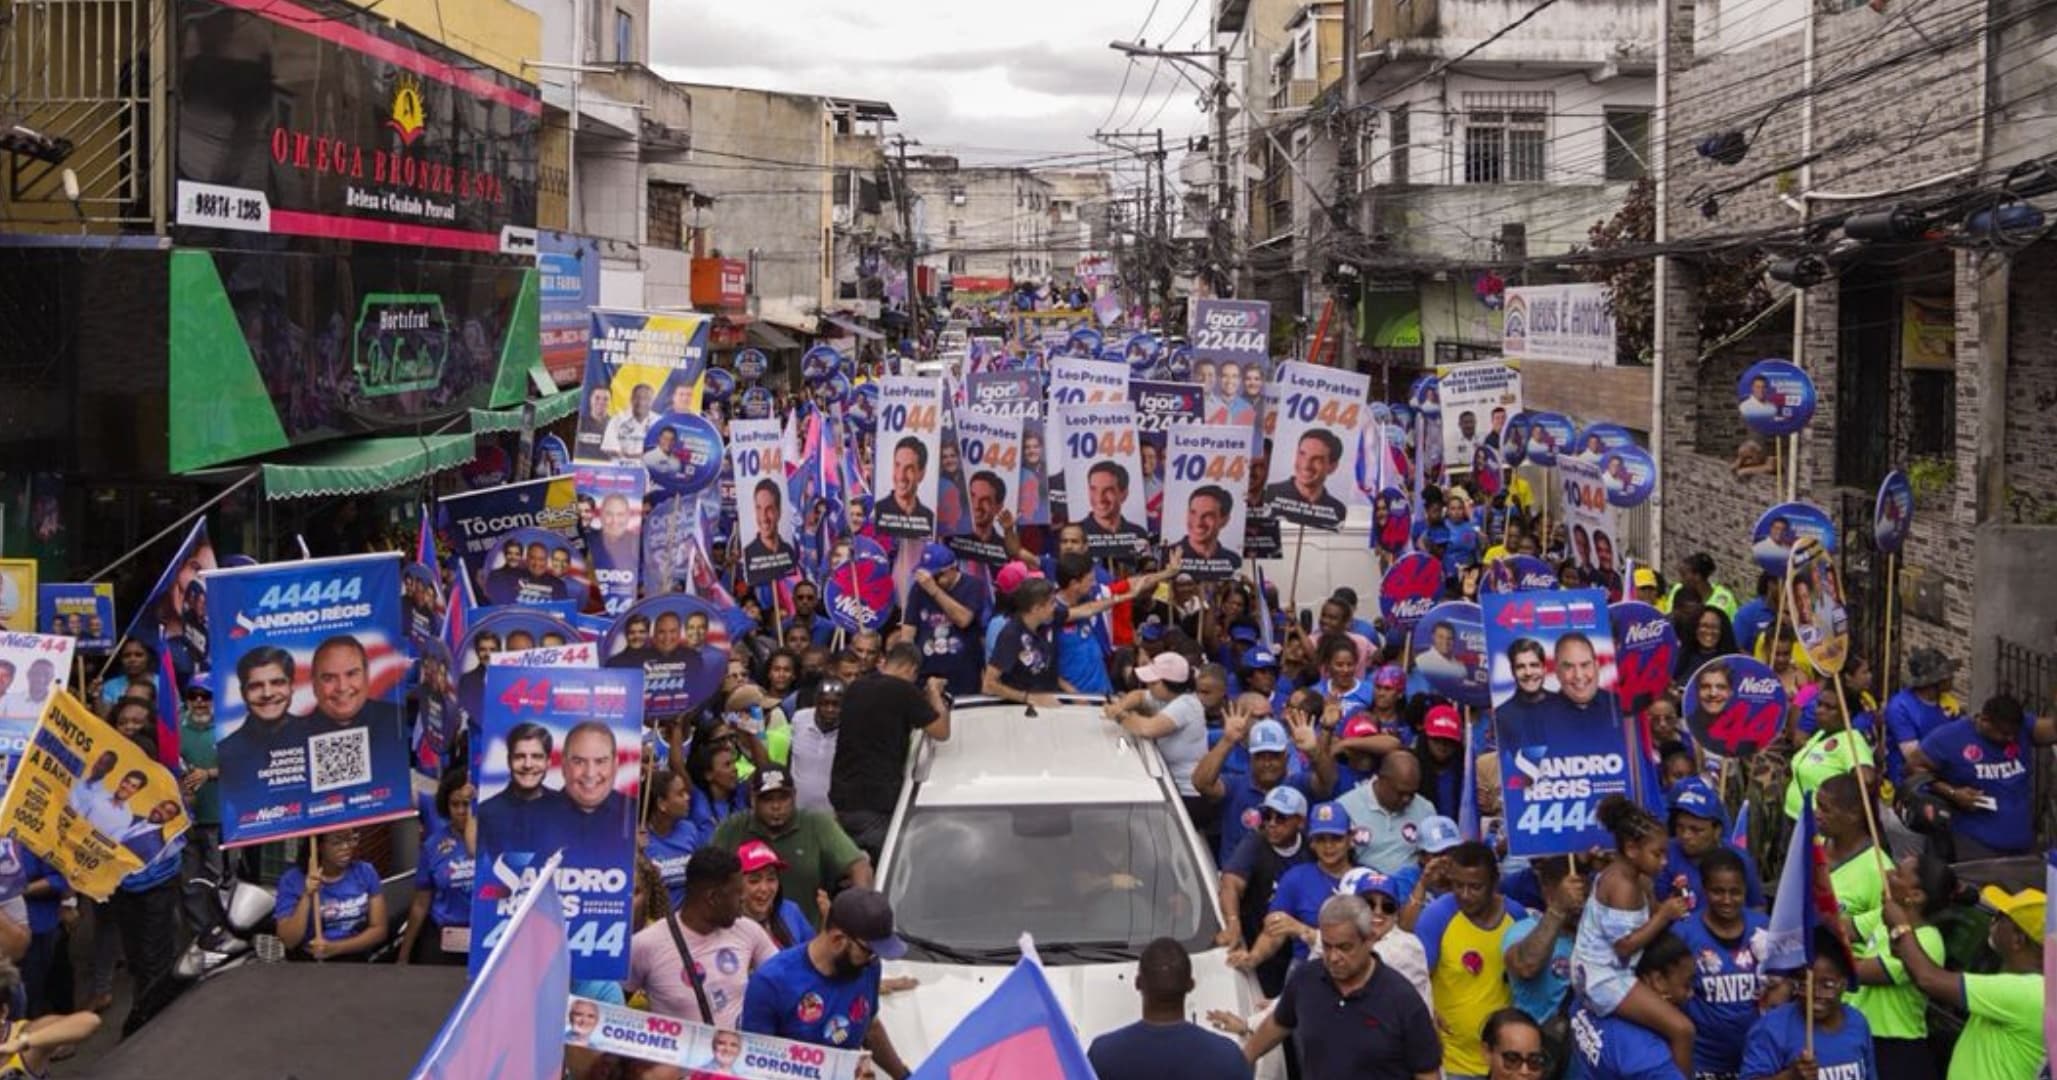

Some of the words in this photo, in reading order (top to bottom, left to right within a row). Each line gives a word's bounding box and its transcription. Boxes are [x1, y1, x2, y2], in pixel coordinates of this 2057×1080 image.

[272, 127, 362, 178] OMEGA
[374, 149, 454, 194] BRONZE
[475, 172, 502, 203] SPA
[1530, 300, 1557, 332] DEUS
[1571, 300, 1611, 336] AMOR
[1197, 329, 1267, 354] 22444
[882, 404, 937, 433] 1044
[1286, 393, 1361, 430] 1044
[960, 437, 1017, 471] 1044
[1067, 427, 1135, 459] 1044
[737, 449, 782, 477] 1044
[1172, 454, 1246, 481] 1044
[1564, 480, 1606, 513] 1044
[458, 517, 489, 536] Tô
[489, 514, 534, 531] com
[536, 503, 578, 522] eles!
[259, 577, 362, 609] 44444
[1521, 573, 1556, 588] Neto
[1391, 598, 1434, 618] Neto
[236, 610, 319, 635] SANDRO
[1625, 619, 1670, 644] Neto
[41, 637, 67, 653] 44
[521, 648, 561, 666] Neto
[562, 646, 590, 663] 44
[1738, 676, 1781, 694] Neto
[48, 705, 94, 753] JUNTOS
[1708, 701, 1782, 756] 44
[1515, 749, 1624, 782] SANDRO
[493, 853, 627, 898] SADRO
[602, 1025, 678, 1051] CORONEL
[646, 1016, 683, 1036] 100
[745, 1054, 821, 1080] CORONEL
[789, 1044, 825, 1065] 100
